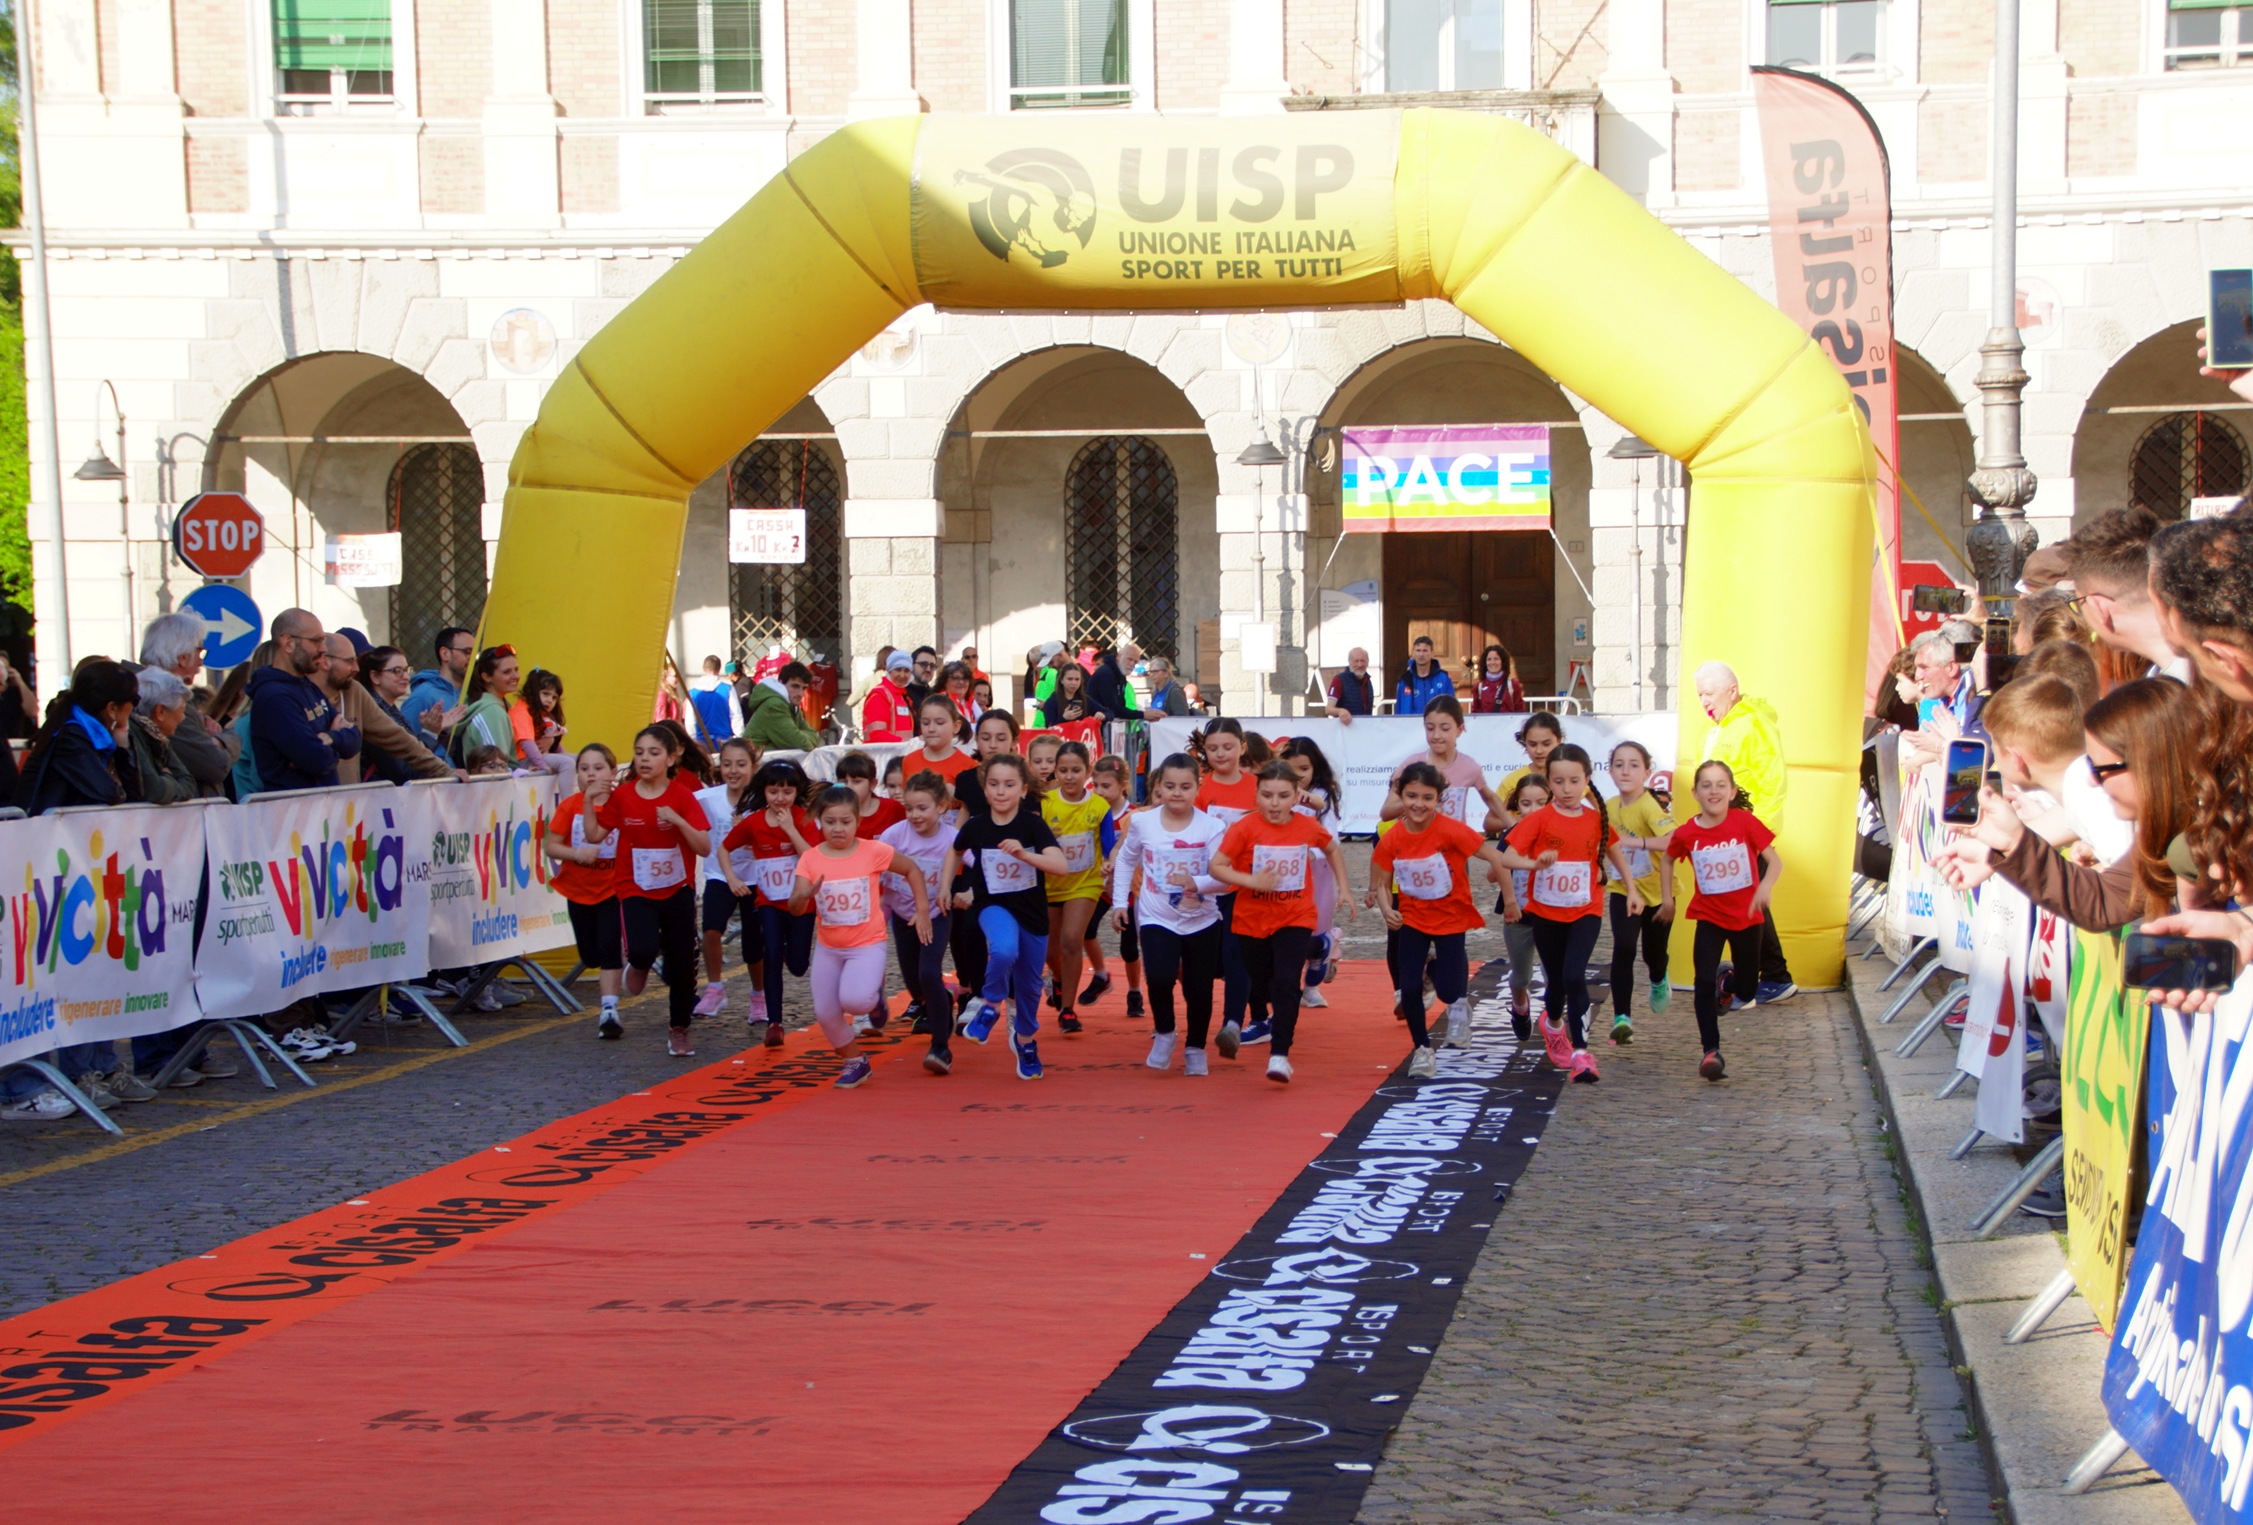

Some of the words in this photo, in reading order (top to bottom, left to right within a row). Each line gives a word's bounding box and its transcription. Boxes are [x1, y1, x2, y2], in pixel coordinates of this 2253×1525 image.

[1118, 144, 1355, 224] UISP
[1118, 230, 1223, 255] UNIONE
[1235, 228, 1356, 254] ITALIANA
[1121, 260, 1203, 280] SPORT
[1217, 259, 1263, 280] PER
[1275, 256, 1343, 277] TUTTI
[1356, 453, 1536, 507] PACE
[185, 518, 260, 552] STOP
[447, 832, 470, 866] UISP
[650, 860, 674, 877] 53
[995, 862, 1022, 880] 92
[1164, 860, 1201, 879] 253
[1264, 858, 1300, 877] 268
[1702, 859, 1740, 881] 299
[763, 868, 794, 888] 107
[1411, 869, 1436, 888] 85
[1545, 873, 1581, 893] 108
[825, 892, 862, 913] 292
[472, 907, 518, 946] includere
[370, 941, 406, 961] innovare
[59, 997, 122, 1027] rigenerare
[124, 992, 169, 1014] innovare
[369, 1409, 788, 1426] LUCCI
[360, 1421, 772, 1436] TRASPORTI
